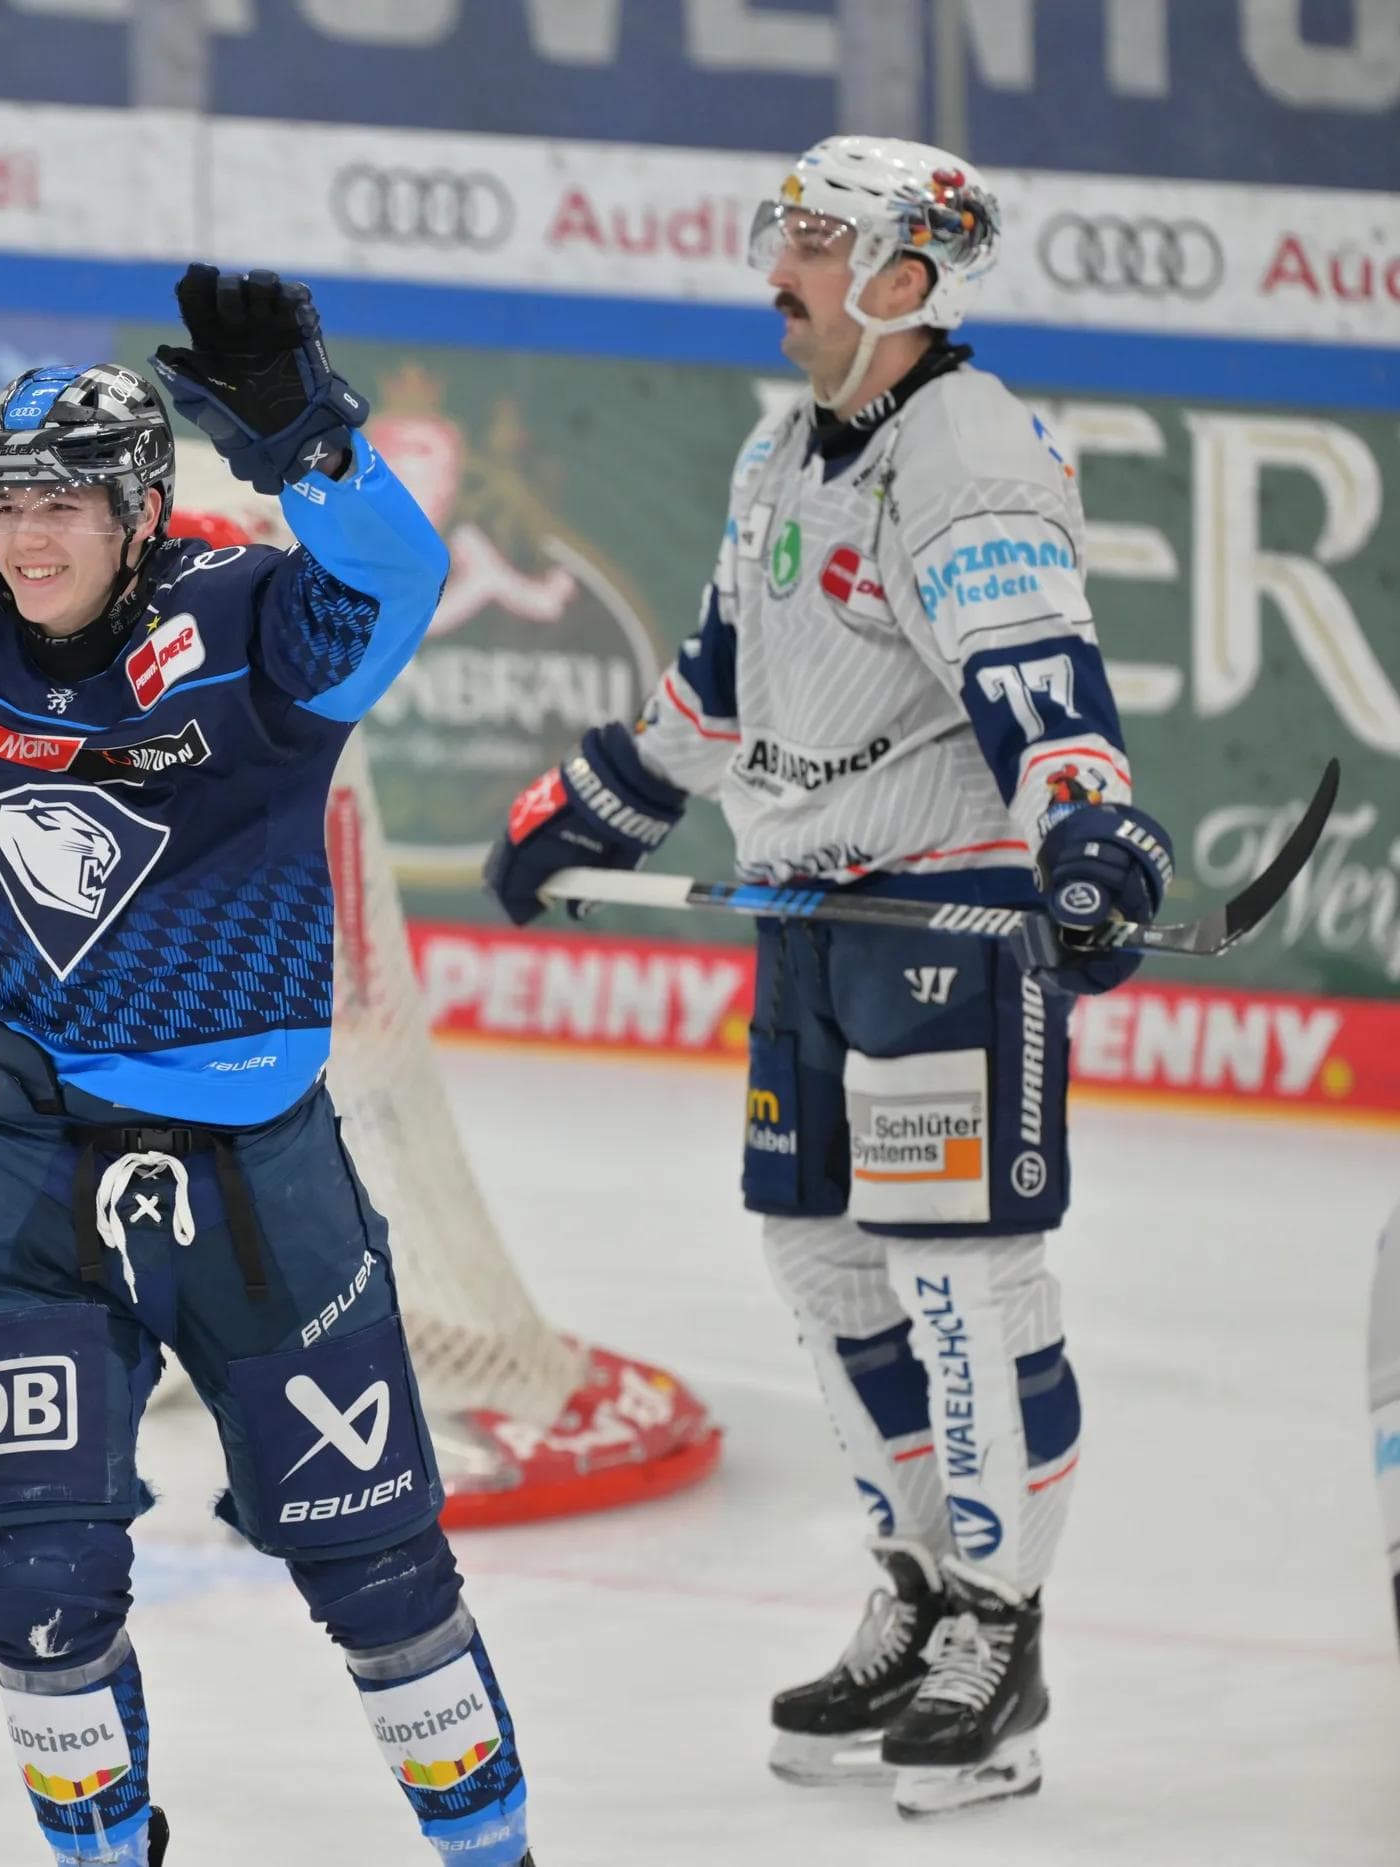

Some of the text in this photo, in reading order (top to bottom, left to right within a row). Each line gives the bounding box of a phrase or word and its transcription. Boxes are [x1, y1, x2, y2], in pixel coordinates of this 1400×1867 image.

[546, 188, 741, 260] Audi
[158, 626, 194, 669] DEL
[975, 653, 1083, 743] 77
[127, 741, 195, 771] SATURN
[1020, 973, 1046, 1146] WARRIO
[852, 1138, 939, 1167] Systems
[875, 1112, 982, 1140] Schlüter
[301, 1249, 377, 1349] BAUER
[279, 1469, 414, 1524] BAUER
